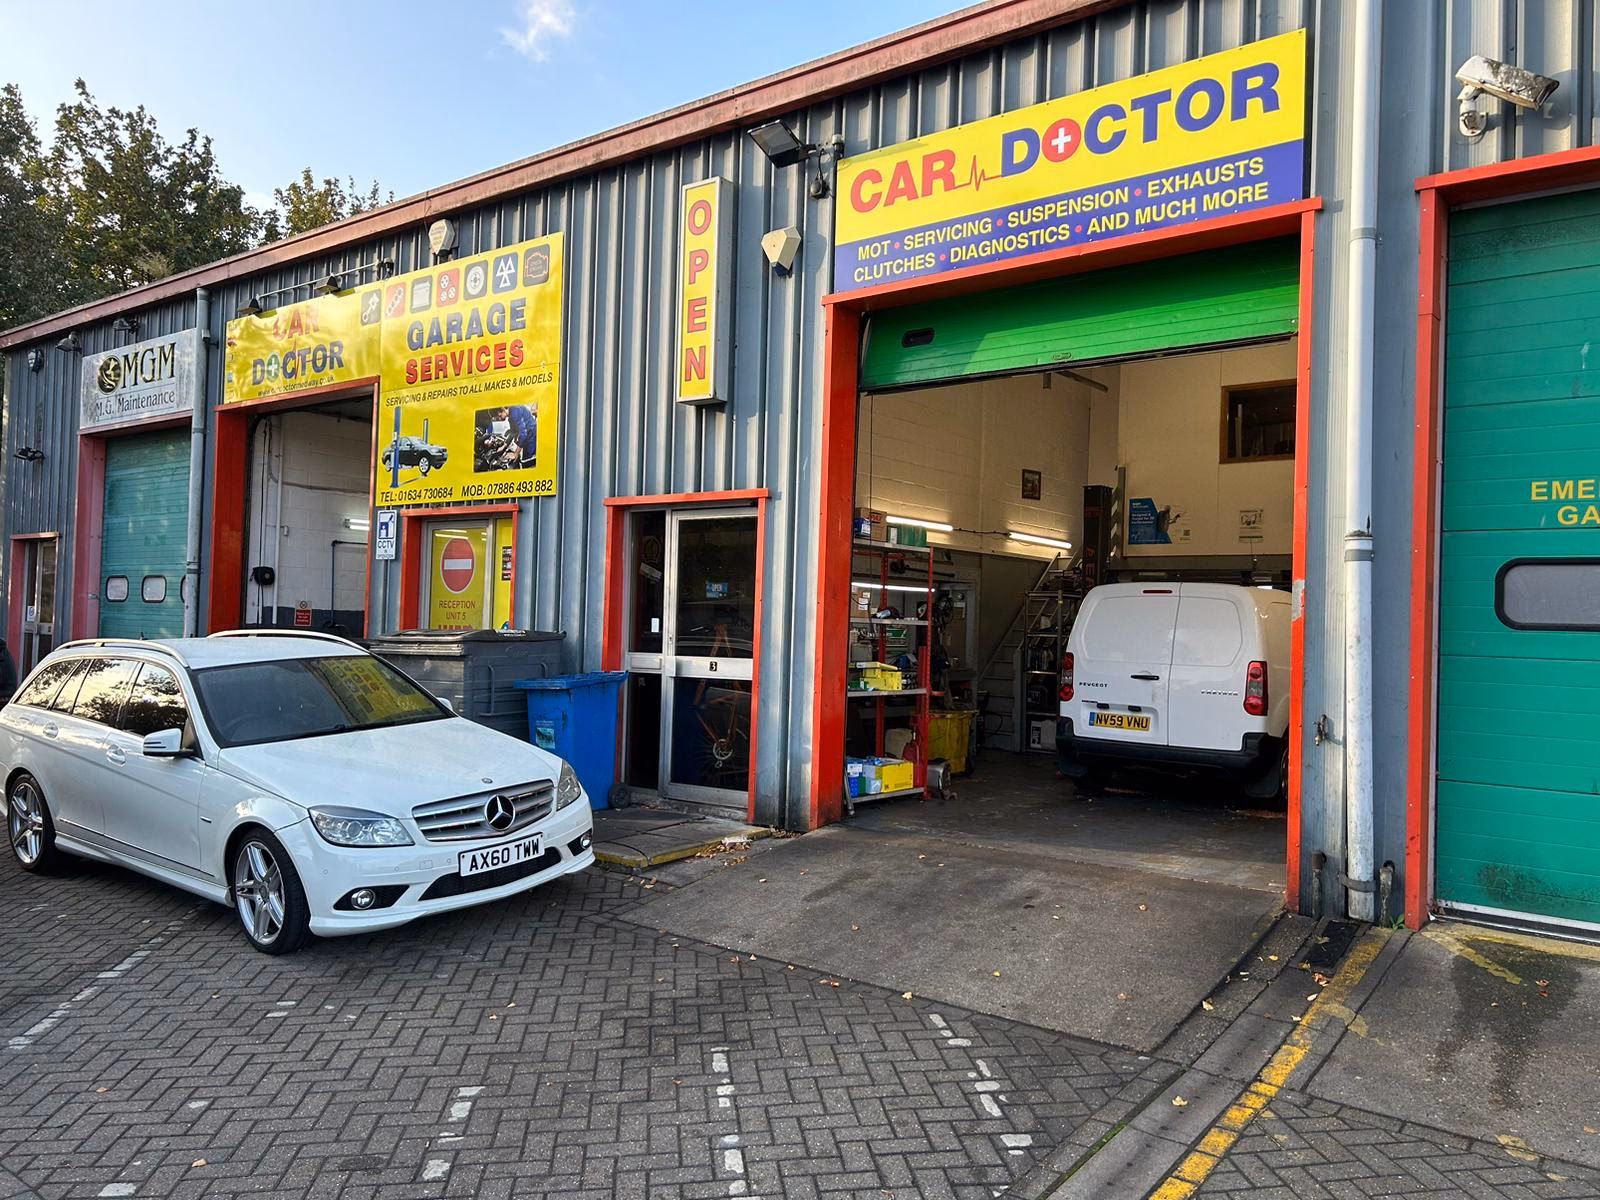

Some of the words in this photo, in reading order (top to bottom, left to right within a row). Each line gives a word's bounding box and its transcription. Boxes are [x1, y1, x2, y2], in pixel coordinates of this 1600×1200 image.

[851, 149, 956, 213] CAR
[858, 240, 891, 261] MOT
[903, 218, 992, 250] SERVICING
[1007, 187, 1129, 228] SUSPENSION
[1147, 157, 1264, 198] EXHAUSTS
[854, 253, 936, 283] CLUTCHES
[950, 224, 1070, 263] DIAGNOSTICS
[1087, 212, 1129, 235] AND
[1135, 197, 1196, 225] MUCH
[1203, 182, 1269, 212] MORE
[685, 200, 712, 382] OPEN
[273, 305, 320, 340] CAR
[407, 298, 527, 351] GARAGE
[121, 342, 176, 389] MGM
[405, 339, 525, 385] SERVICES
[118, 390, 175, 412] Maintenance
[385, 392, 422, 407] SERVICING
[422, 391, 427, 401] &
[427, 388, 458, 401] REPAIRS
[459, 386, 470, 396] TO
[469, 382, 483, 394] ALL
[484, 378, 512, 392] MAKES
[512, 377, 518, 388] &
[518, 372, 553, 387] MODELS
[380, 491, 398, 502] TEL:
[398, 489, 422, 501] 01634
[423, 487, 454, 500] 730684
[461, 485, 486, 497] MOB:
[487, 482, 515, 495] 07886
[516, 481, 533, 492] 493
[535, 480, 553, 491] 882
[1530, 480, 1600, 500] EME
[378, 540, 394, 549] CCTV
[439, 600, 476, 609] RECEPTION
[446, 612, 460, 620] UNIT
[462, 611, 466, 620] 5
[710, 661, 717, 671] 3
[1096, 713, 1123, 728] NV59
[1127, 715, 1148, 729] VNU
[469, 847, 510, 871] AX60
[514, 838, 539, 860] TWW
